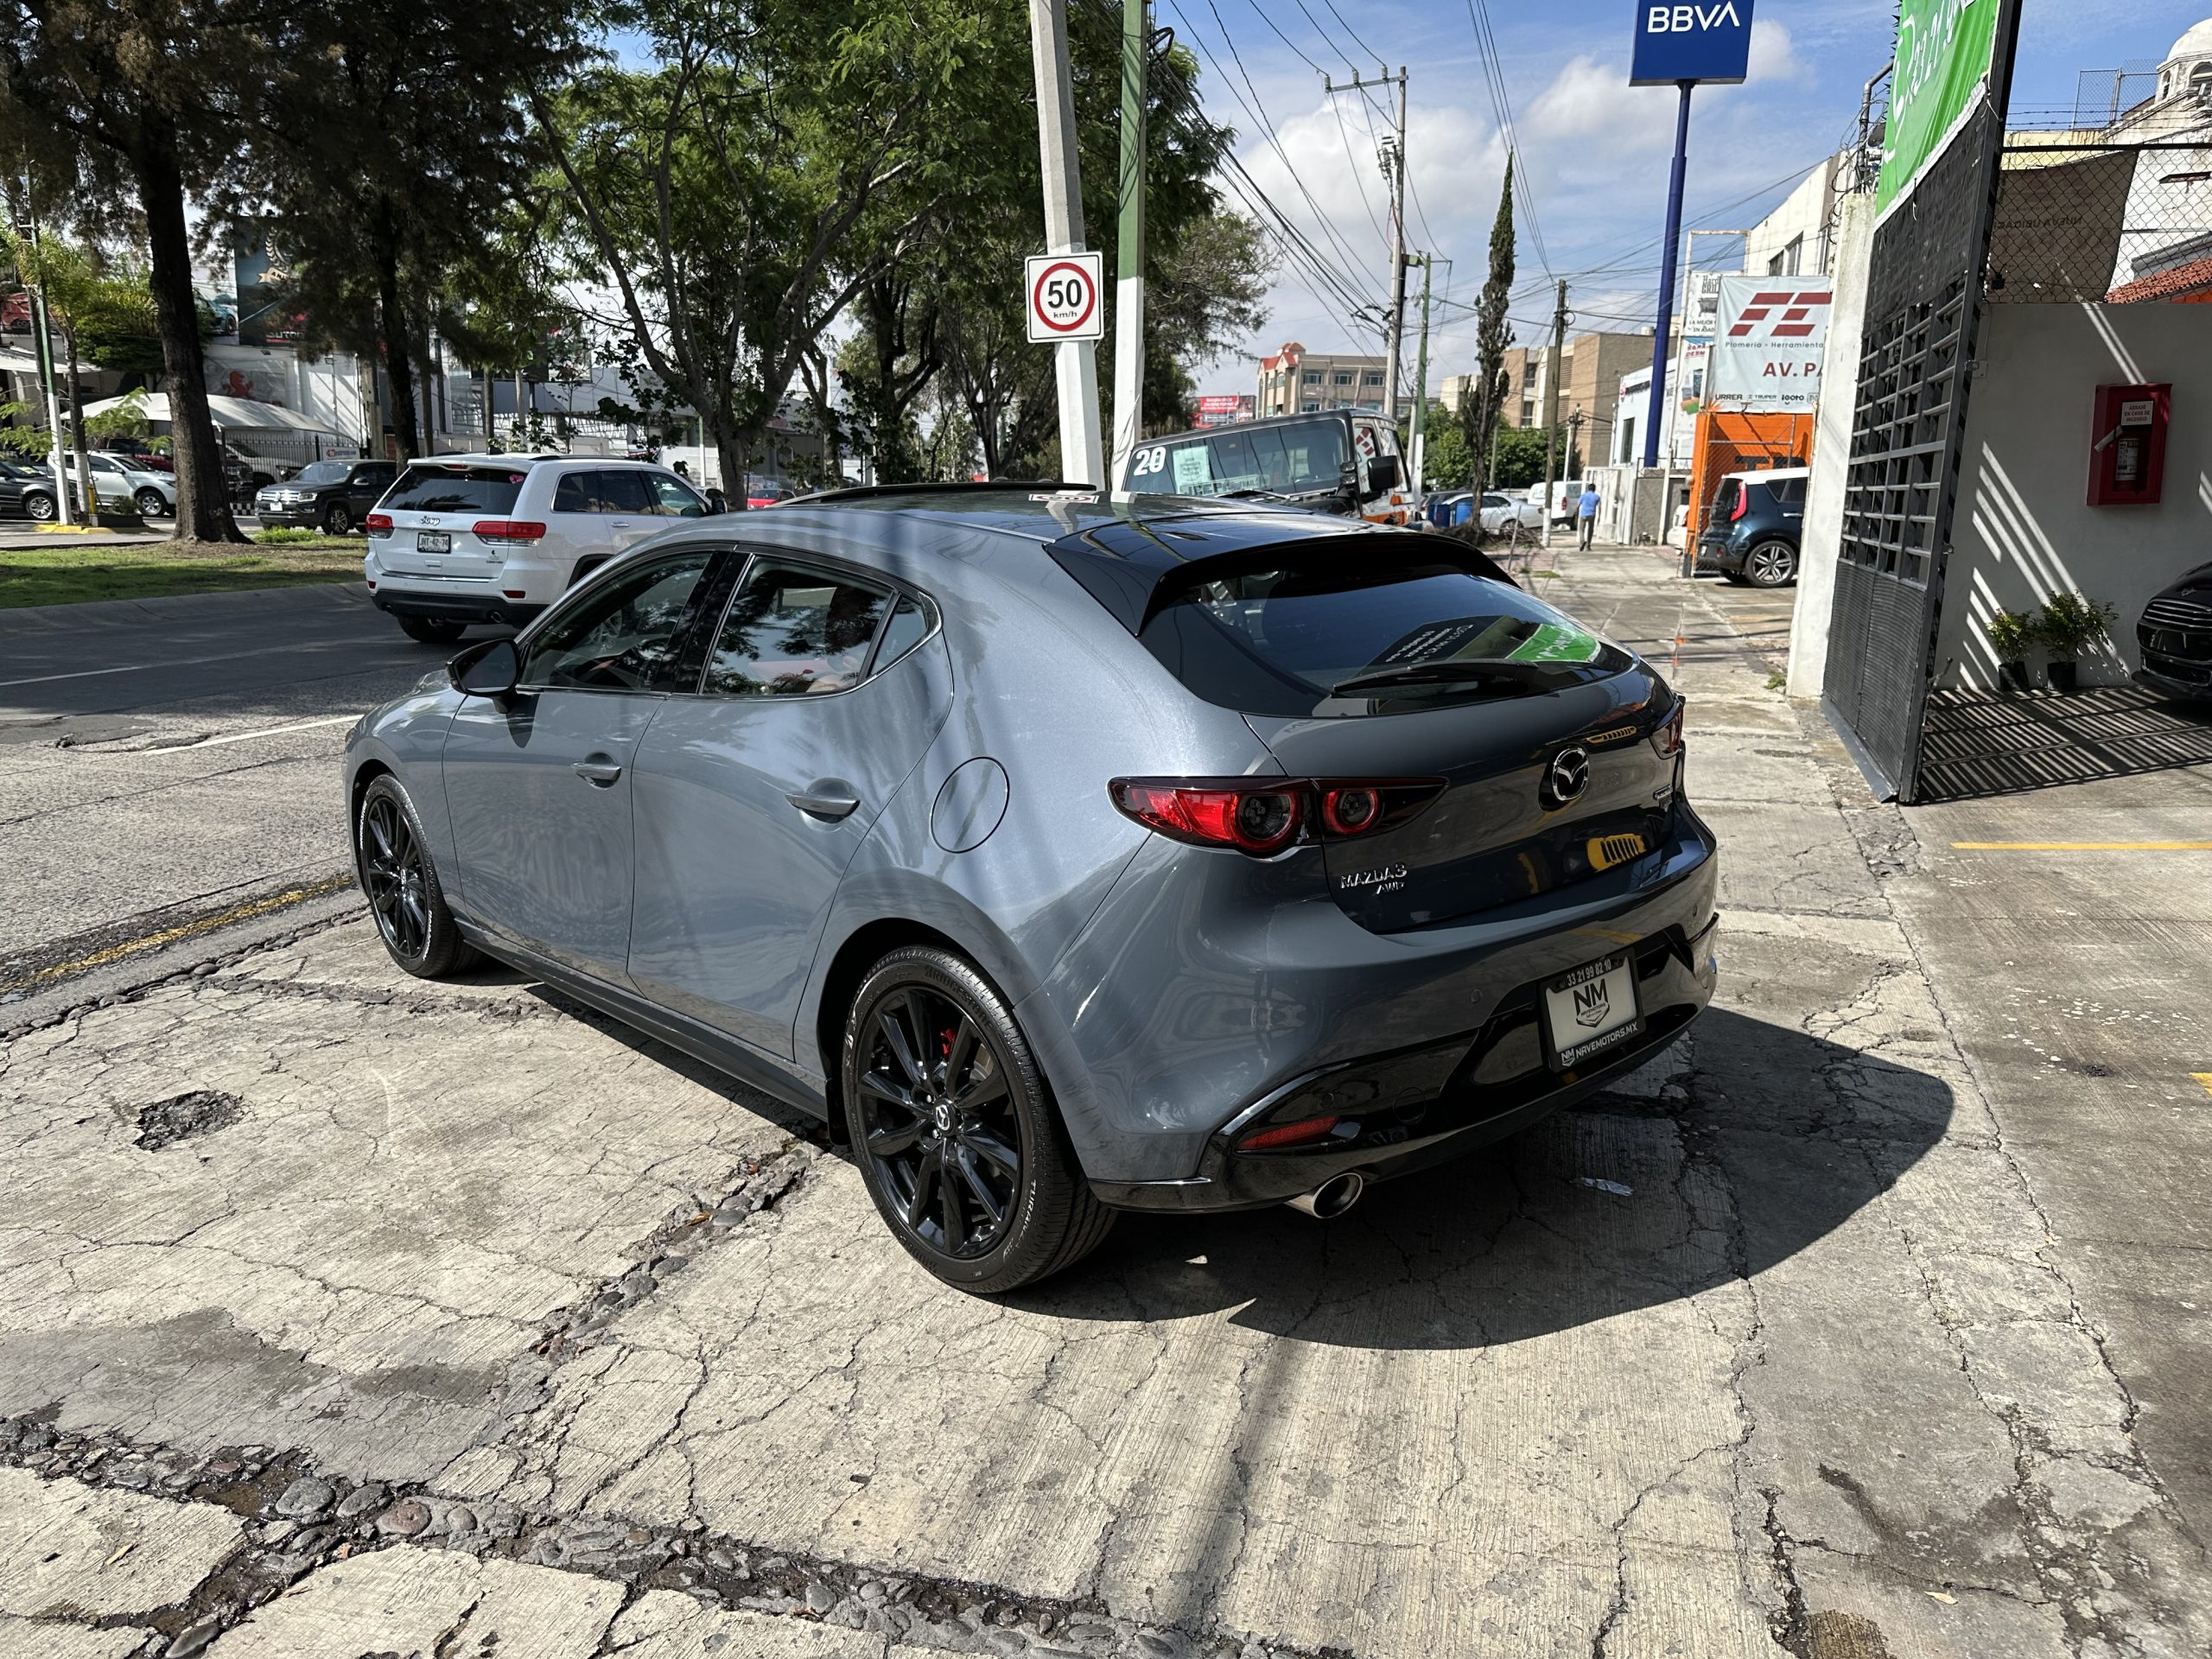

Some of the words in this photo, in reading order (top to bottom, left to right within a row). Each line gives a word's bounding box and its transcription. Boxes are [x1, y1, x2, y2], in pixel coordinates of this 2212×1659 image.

[1648, 1, 1740, 33] BBVA
[1047, 279, 1082, 308] 50
[1763, 363, 1798, 377] AV.
[1134, 446, 1166, 476] 20
[420, 516, 441, 526] Jeep
[1567, 973, 1576, 987] 33
[1577, 970, 1586, 983] 21
[1585, 967, 1594, 980] 99
[1594, 963, 1604, 976] 82
[1604, 959, 1611, 971] 10
[924, 964, 994, 1031] BRIDGESTONE
[1573, 978, 1609, 1016] NM
[1560, 1048, 1575, 1061] NM
[1575, 1021, 1638, 1058] NAVEMOTORS.MX
